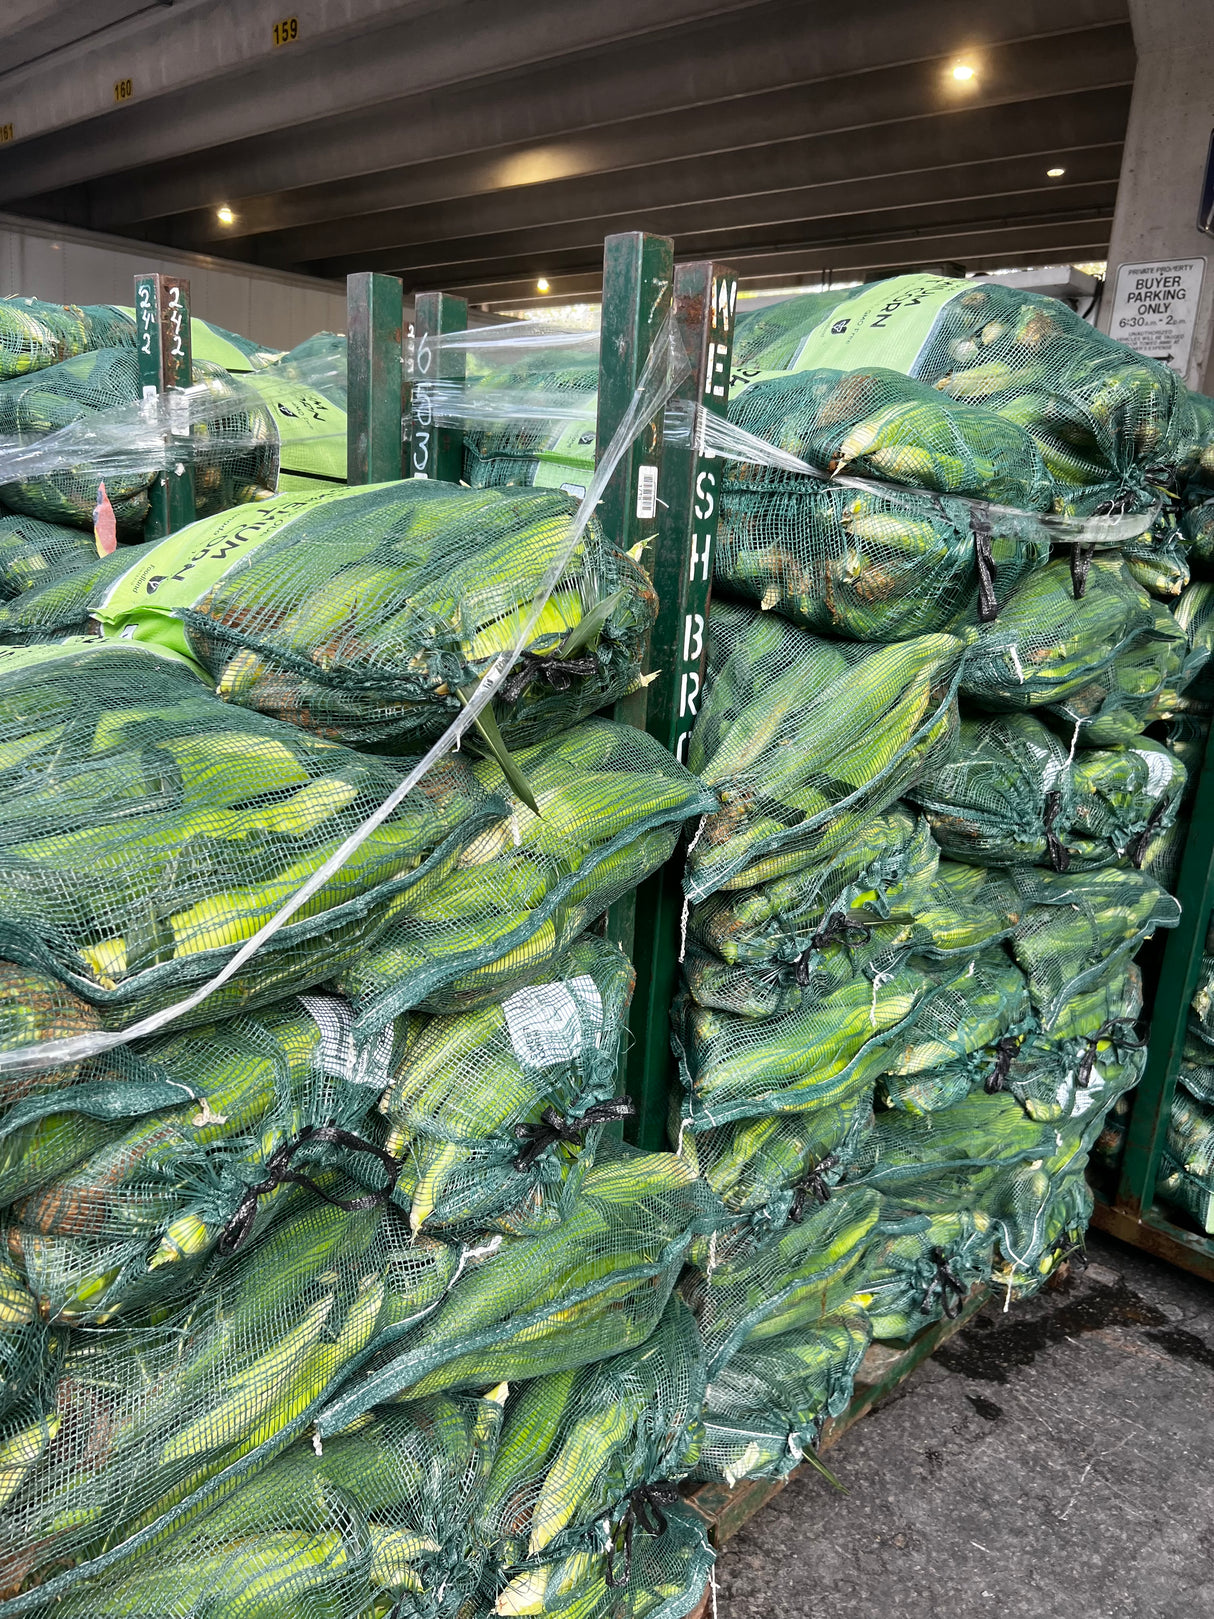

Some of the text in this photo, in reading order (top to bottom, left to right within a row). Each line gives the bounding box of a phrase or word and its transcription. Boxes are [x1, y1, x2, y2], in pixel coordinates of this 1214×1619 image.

[274, 18, 298, 45] 159
[115, 79, 132, 101] 160
[1128, 265, 1194, 275] PRIVATE PROPERTY
[1135, 276, 1182, 290] BUYER
[1127, 289, 1187, 303] PARKING
[1137, 302, 1172, 315] ONLY
[168, 287, 186, 356] 242
